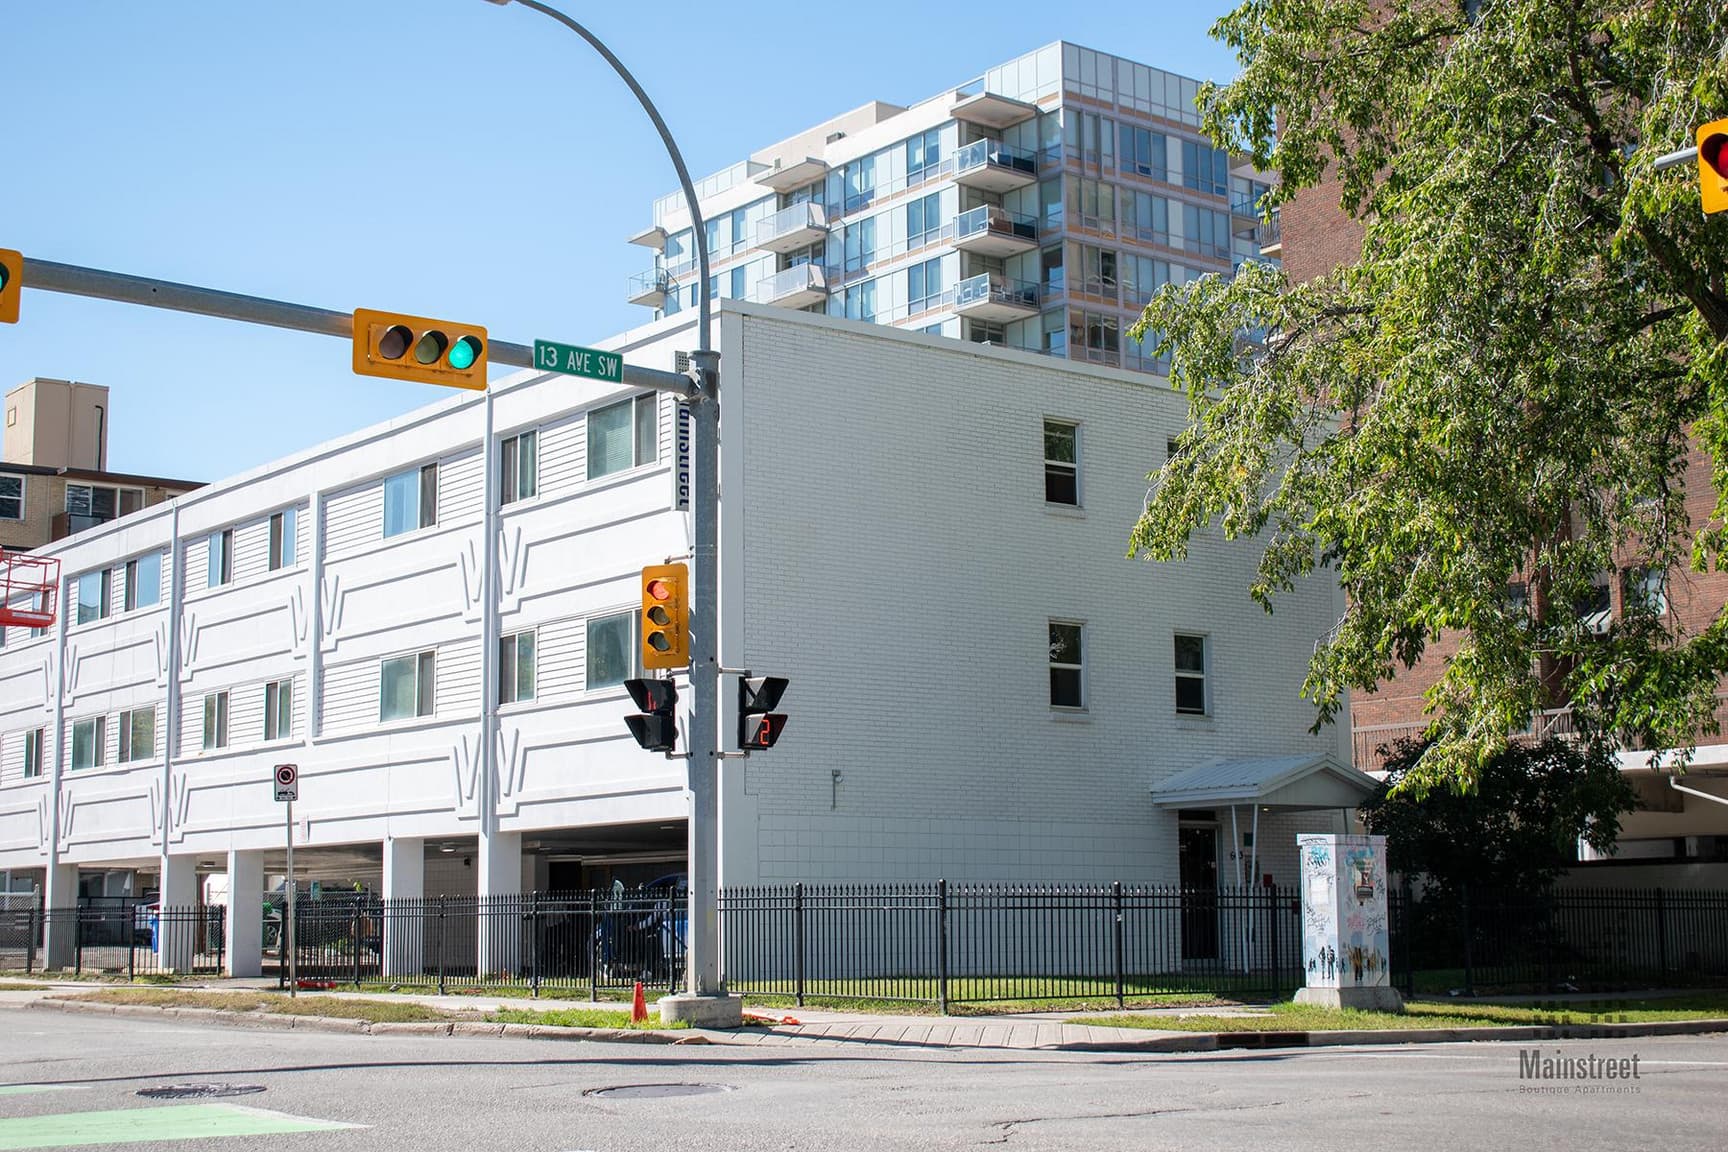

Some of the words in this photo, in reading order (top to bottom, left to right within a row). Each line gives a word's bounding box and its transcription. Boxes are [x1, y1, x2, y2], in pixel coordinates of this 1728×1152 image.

[539, 345, 558, 367] 13
[567, 350, 592, 373] AVE
[598, 355, 618, 378] SW
